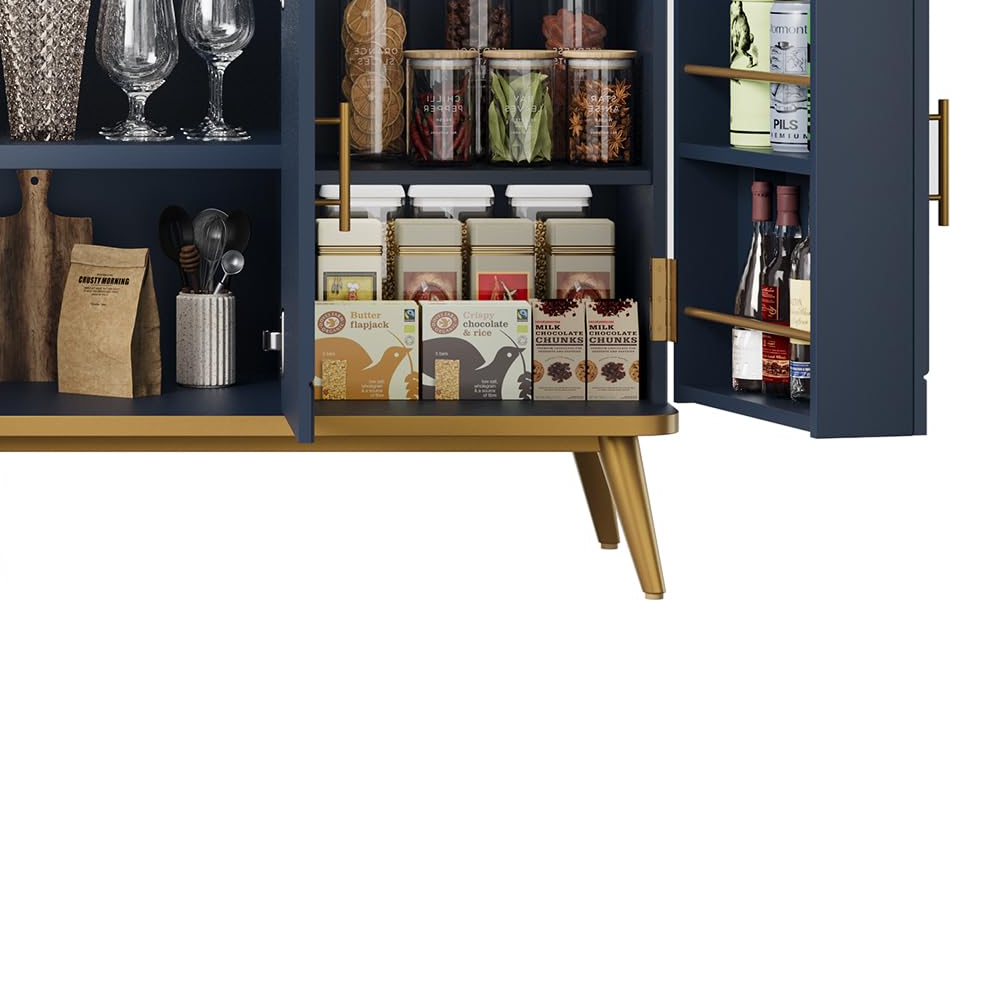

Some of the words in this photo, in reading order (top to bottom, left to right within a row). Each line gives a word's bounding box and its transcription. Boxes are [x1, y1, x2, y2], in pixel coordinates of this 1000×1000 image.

[774, 118, 799, 130] PILS
[350, 312, 382, 320] Butter
[462, 312, 495, 320] Crispy
[350, 320, 390, 330] flapjack
[462, 320, 508, 328] chocolate
[473, 328, 492, 336] rice
[535, 336, 584, 344] CHUNKS
[589, 336, 638, 344] CHUNKS
